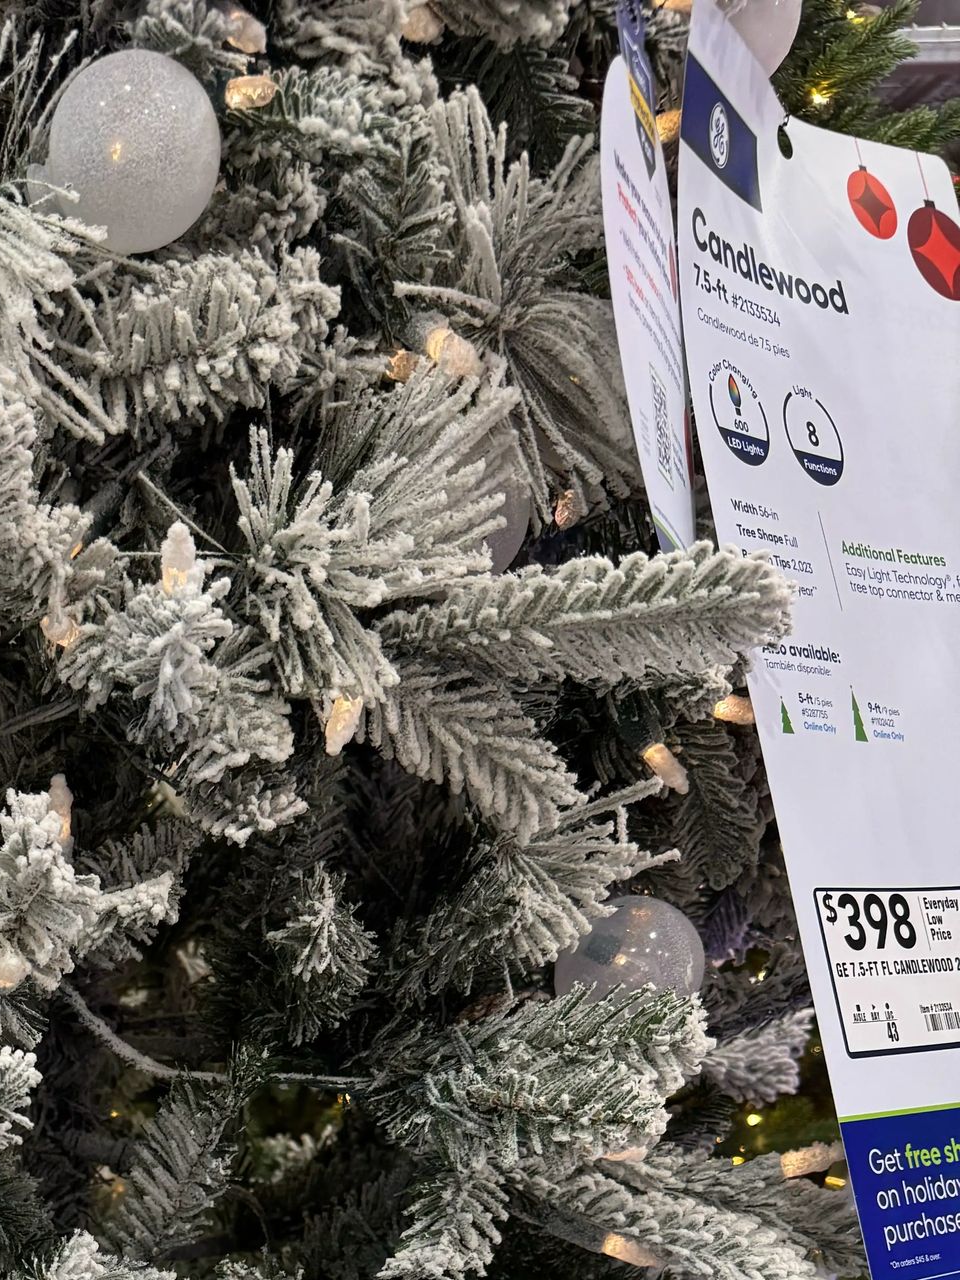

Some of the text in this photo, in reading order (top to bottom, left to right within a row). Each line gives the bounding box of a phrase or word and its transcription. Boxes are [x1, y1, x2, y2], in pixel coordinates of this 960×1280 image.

[692, 207, 849, 315] Candlewood
[693, 262, 729, 305] 7.5-ft
[731, 292, 781, 327] #2133534
[697, 307, 790, 359] Candlewood de 7.5 pies
[708, 359, 758, 400] Color Changing
[792, 385, 813, 400] Light
[734, 418, 749, 433] 600
[806, 421, 820, 447] 8
[727, 436, 765, 457] LED Lights
[803, 458, 838, 477] Functions
[730, 498, 780, 521] Width 56-in
[736, 523, 799, 549] Tree Shape Full
[841, 539, 947, 567] Additional Features
[773, 554, 791, 570] Tips
[791, 558, 814, 574] 2,023
[845, 562, 866, 581] Easy
[867, 565, 892, 584] Light
[849, 580, 868, 594] tree
[868, 584, 885, 599] top
[885, 587, 934, 602] connector
[935, 589, 945, 602] &
[789, 643, 842, 664] available:
[764, 658, 832, 677] También disponible:
[798, 692, 814, 705] 5-ft
[867, 702, 881, 714] 9-ft
[803, 721, 837, 735] Online Only
[873, 729, 904, 743] Online Only
[923, 896, 959, 913] Everyday
[822, 891, 917, 951] $398
[926, 913, 944, 925] Low
[930, 928, 952, 941] Price
[836, 961, 849, 978] GE
[850, 960, 880, 978] 7.5-FT
[881, 959, 893, 976] FL
[893, 956, 954, 975] CANDLEWOOD
[853, 1009, 895, 1022] AISLE BAY LOC
[887, 1021, 900, 1042] 43
[868, 1148, 904, 1175] Get
[904, 1142, 942, 1169] free
[876, 1188, 902, 1210] on
[900, 1257, 915, 1267] orders
[914, 1255, 925, 1264] $45
